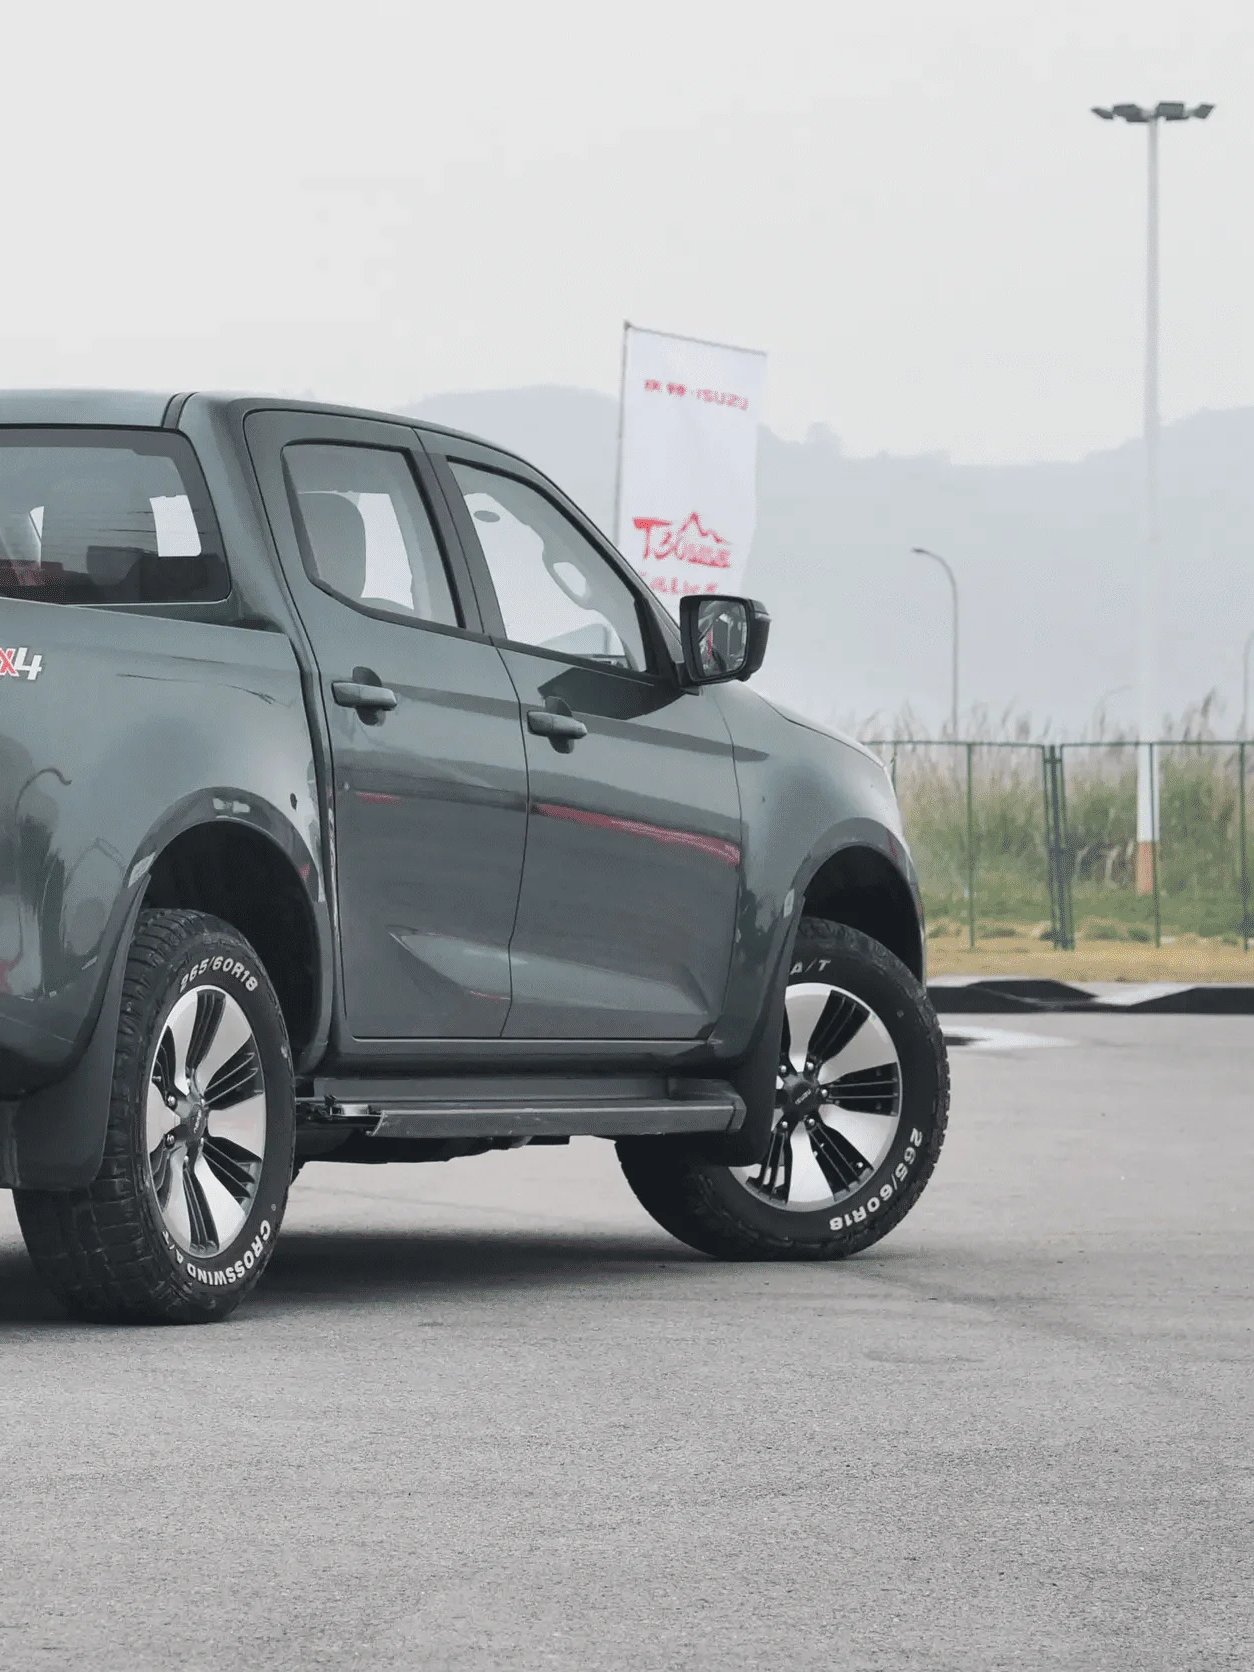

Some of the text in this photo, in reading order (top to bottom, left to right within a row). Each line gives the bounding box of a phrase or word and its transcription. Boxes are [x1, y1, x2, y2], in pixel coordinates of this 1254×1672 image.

[179, 956, 258, 992] 265/60R18
[790, 959, 831, 975] A/T
[829, 1127, 923, 1231] 265/60R18
[186, 1219, 271, 1286] CROSSWIND
